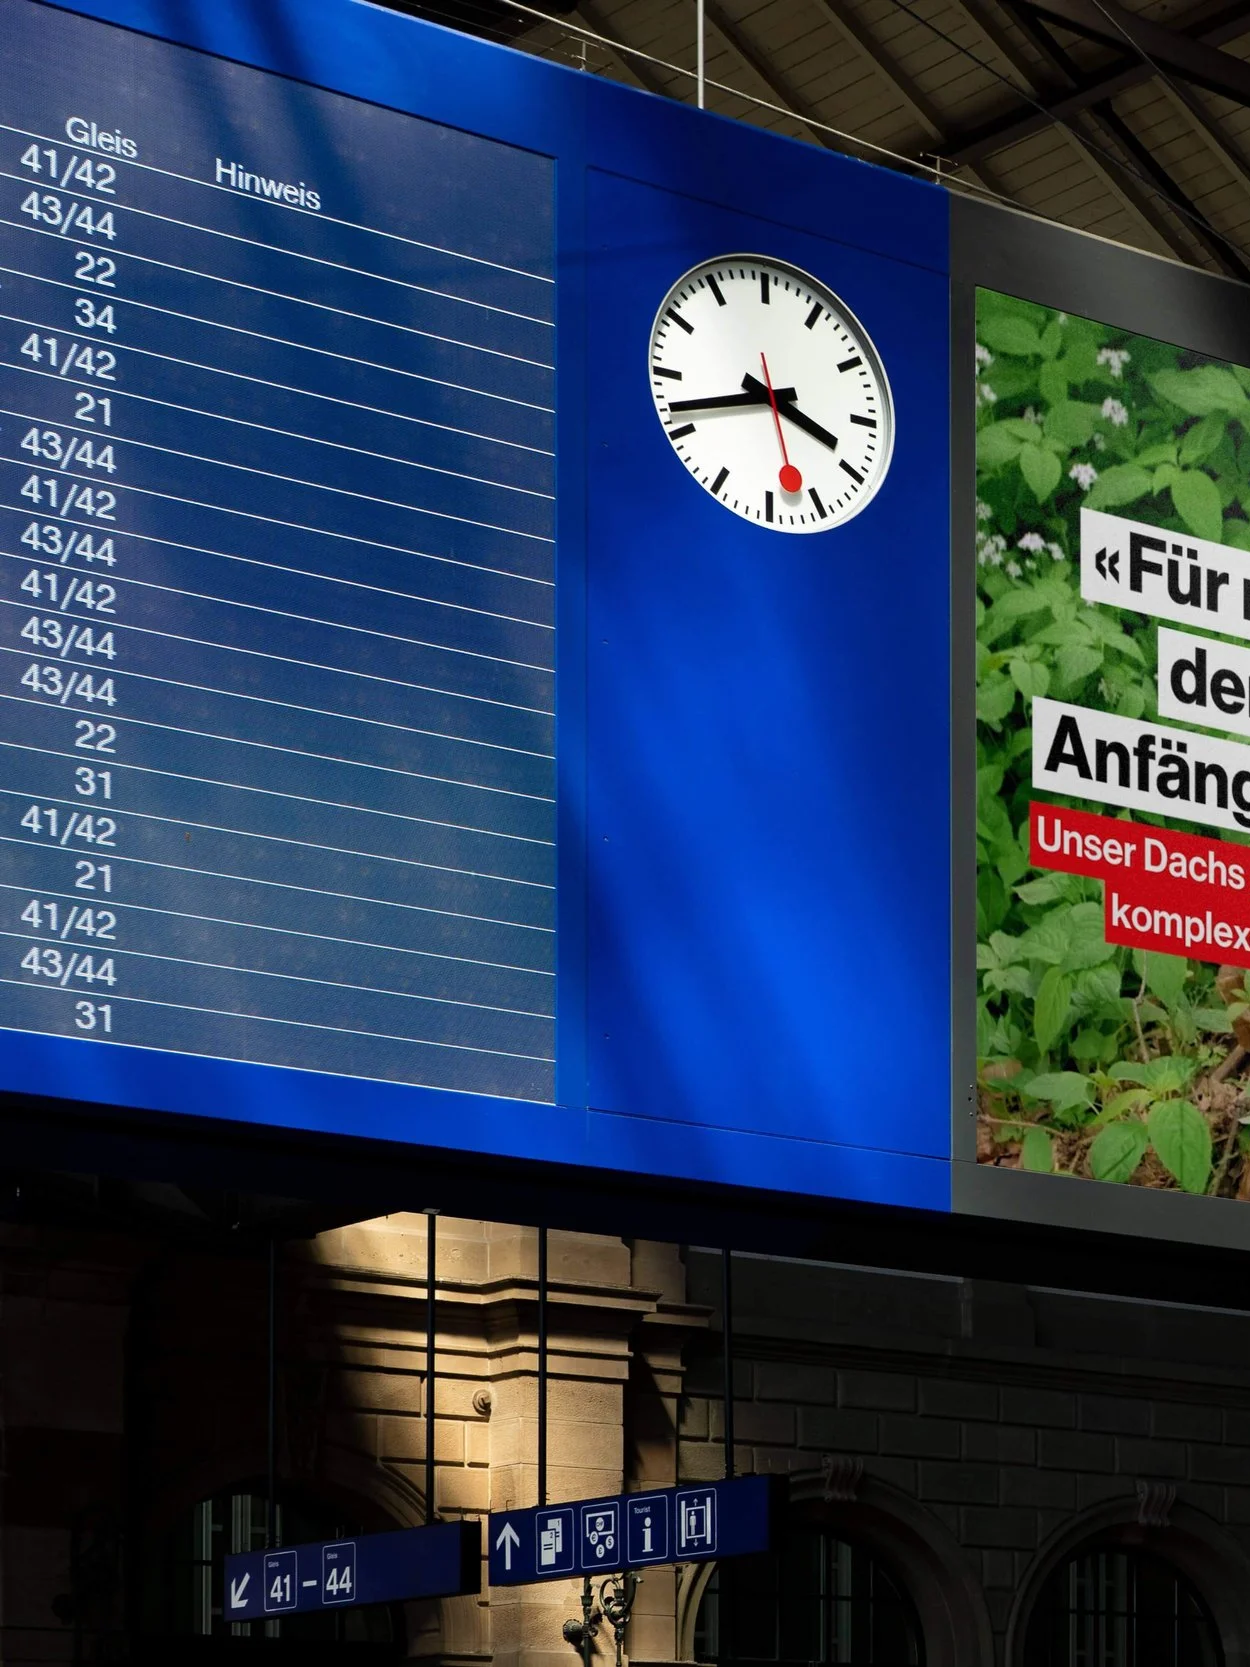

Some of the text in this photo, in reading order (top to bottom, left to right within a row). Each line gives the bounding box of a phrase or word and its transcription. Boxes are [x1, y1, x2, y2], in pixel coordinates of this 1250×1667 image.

[65, 116, 138, 158] Gleis
[20, 143, 117, 194] 41/42
[215, 157, 321, 211] Hinweis
[20, 190, 117, 241] 43/44
[74, 251, 117, 288] 22
[74, 298, 117, 335] 34
[20, 332, 117, 381] 41/42
[74, 391, 112, 427] 21
[20, 427, 117, 474] 43/44
[20, 474, 117, 521] 41/42
[20, 521, 117, 567] 43/44
[20, 568, 117, 614] 41/42
[1094, 531, 1229, 614] «Für
[20, 615, 117, 661] 43/44
[20, 662, 117, 707] 43/44
[74, 719, 117, 754] 22
[74, 766, 112, 800] 31
[20, 805, 117, 847] 41/42
[1036, 816, 1136, 868] Unser
[1143, 838, 1245, 891] Dachs
[74, 861, 112, 894] 21
[20, 899, 117, 940] 41/42
[20, 946, 117, 987] 43/44
[74, 1000, 112, 1033] 31
[634, 1506, 651, 1514] Tourist
[270, 1574, 290, 1603] 41
[326, 1566, 352, 1596] 44
